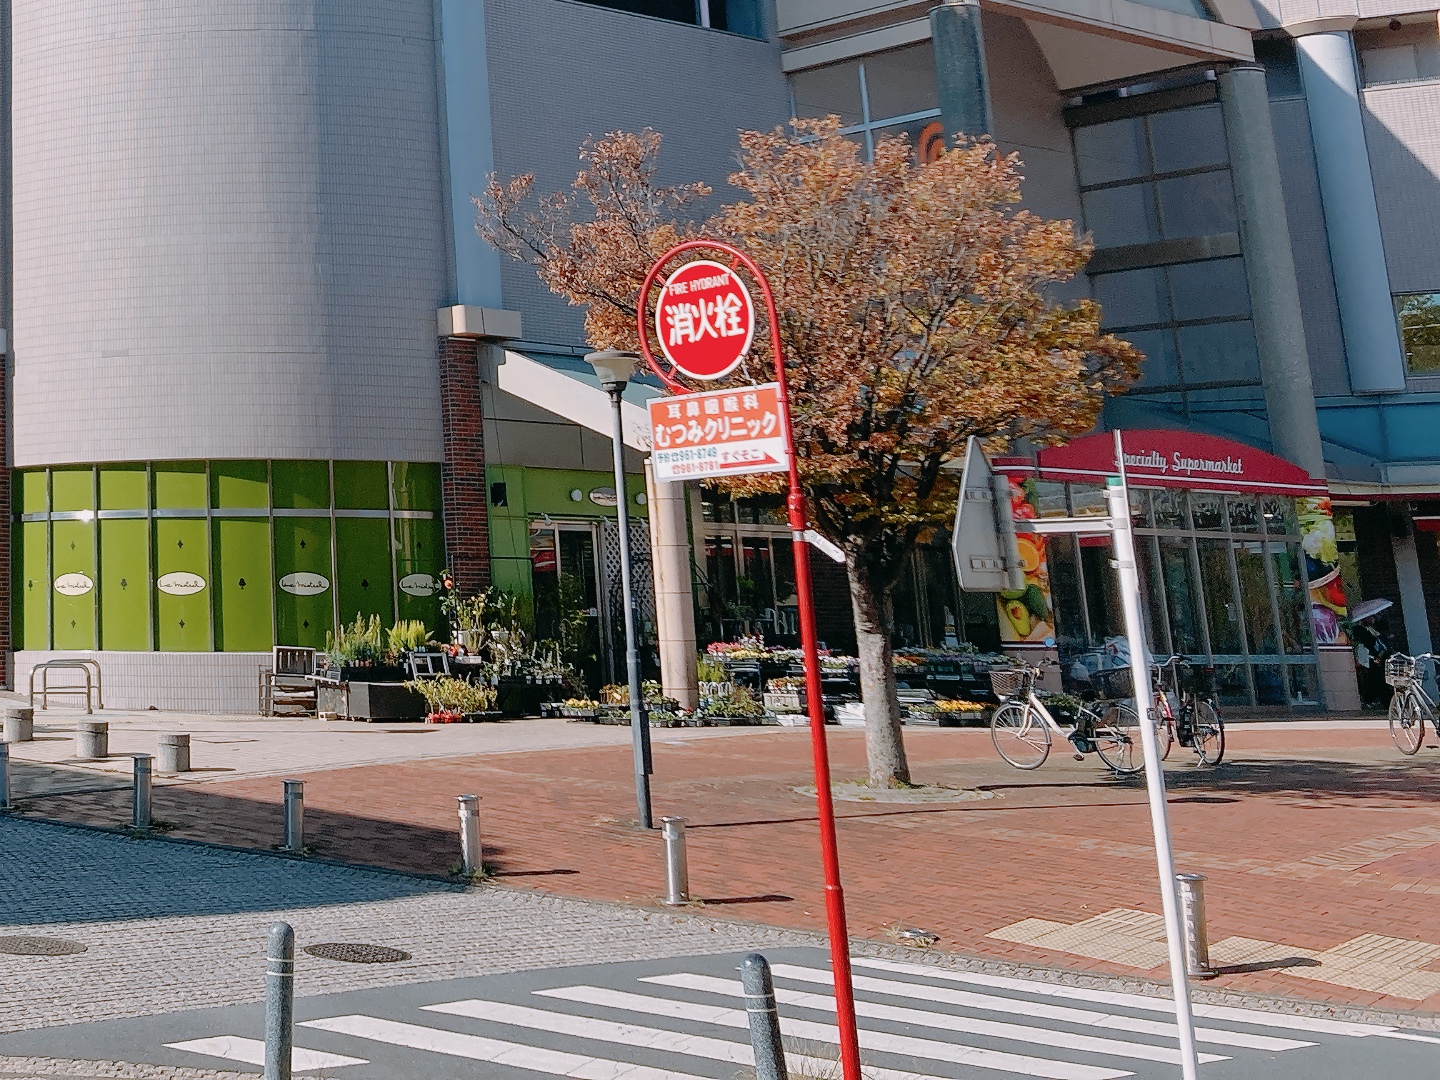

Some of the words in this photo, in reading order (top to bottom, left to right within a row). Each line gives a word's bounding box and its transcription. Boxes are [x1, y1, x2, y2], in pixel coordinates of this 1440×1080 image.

[668, 282, 689, 296] FIRE
[690, 274, 730, 292] HYDRANT
[665, 293, 746, 347] 消火栓
[655, 411, 777, 447] むつみクリニック
[721, 449, 760, 462] すぐそこ
[1171, 452, 1244, 475] Supermarket
